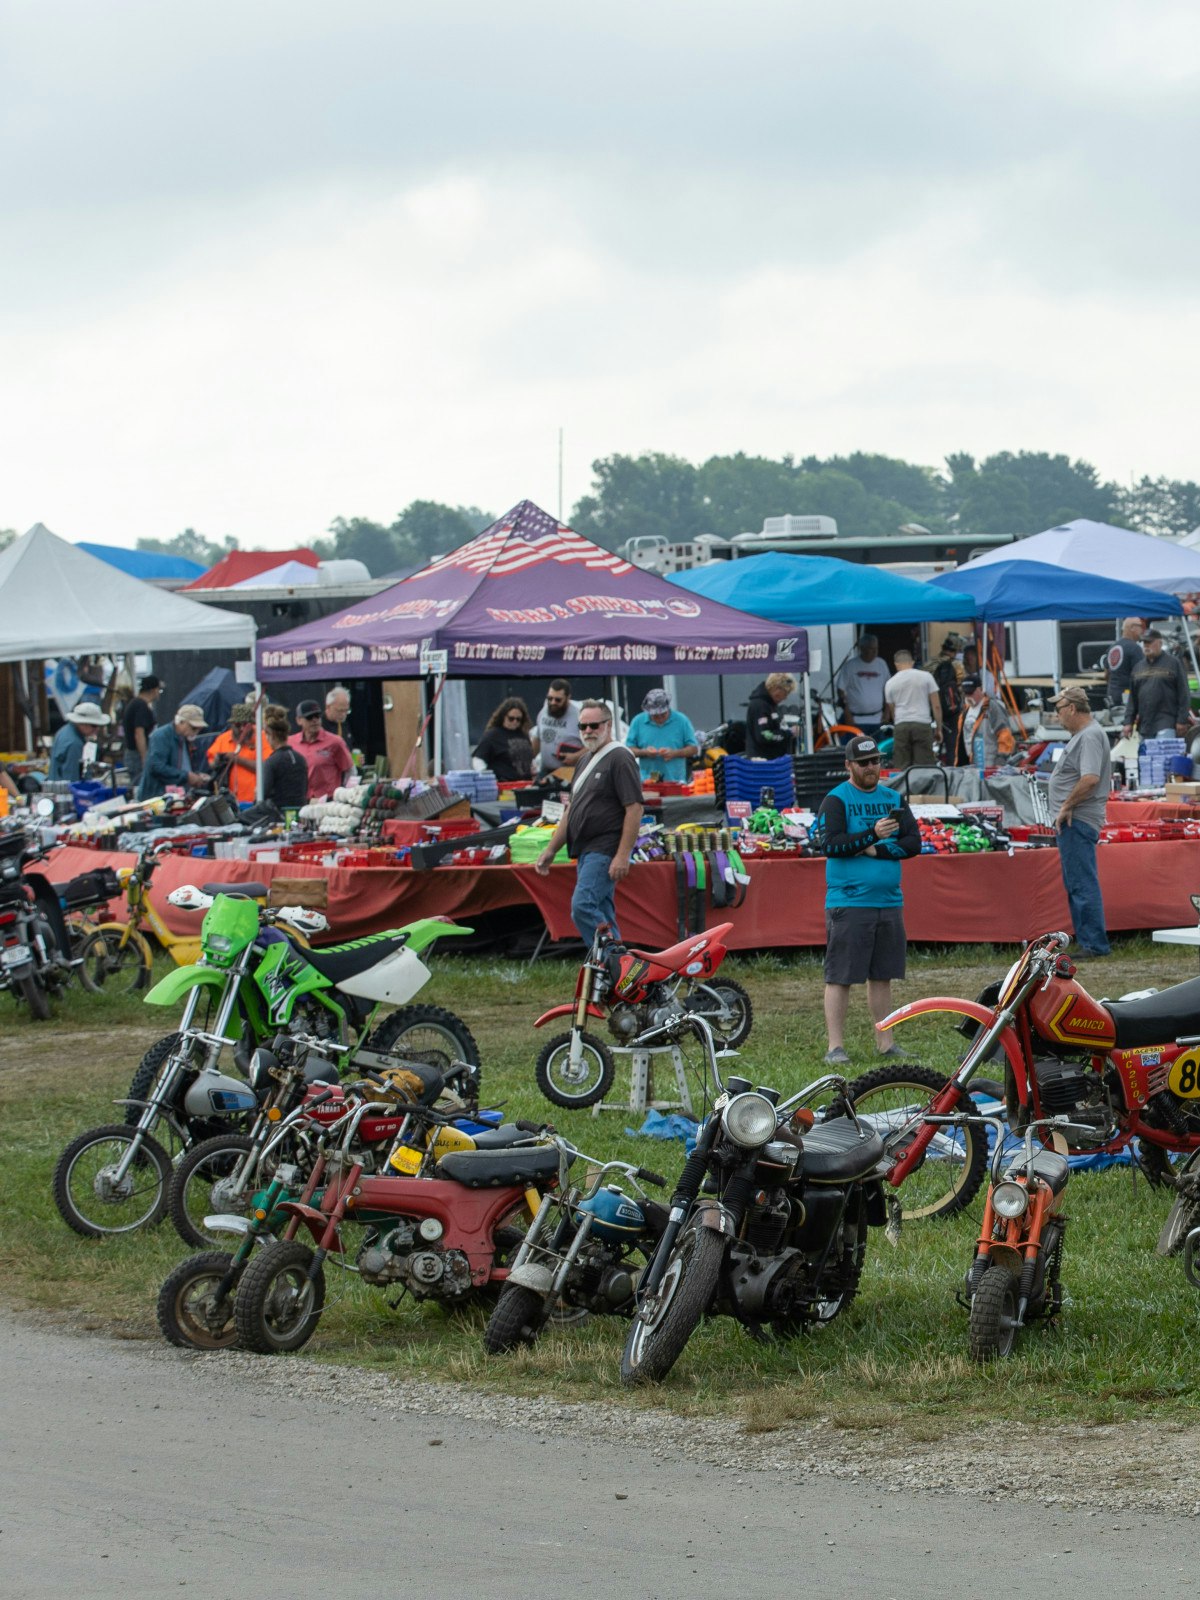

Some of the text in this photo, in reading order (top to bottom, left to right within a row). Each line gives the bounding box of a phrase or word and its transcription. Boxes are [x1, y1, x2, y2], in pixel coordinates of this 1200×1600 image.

[491, 644, 514, 660] Tent
[516, 645, 546, 661] $999
[598, 645, 621, 661] Tent
[623, 645, 657, 661] $1099
[848, 804, 862, 817] FLY
[703, 951, 713, 973] 5
[1069, 1018, 1105, 1030] MAICO
